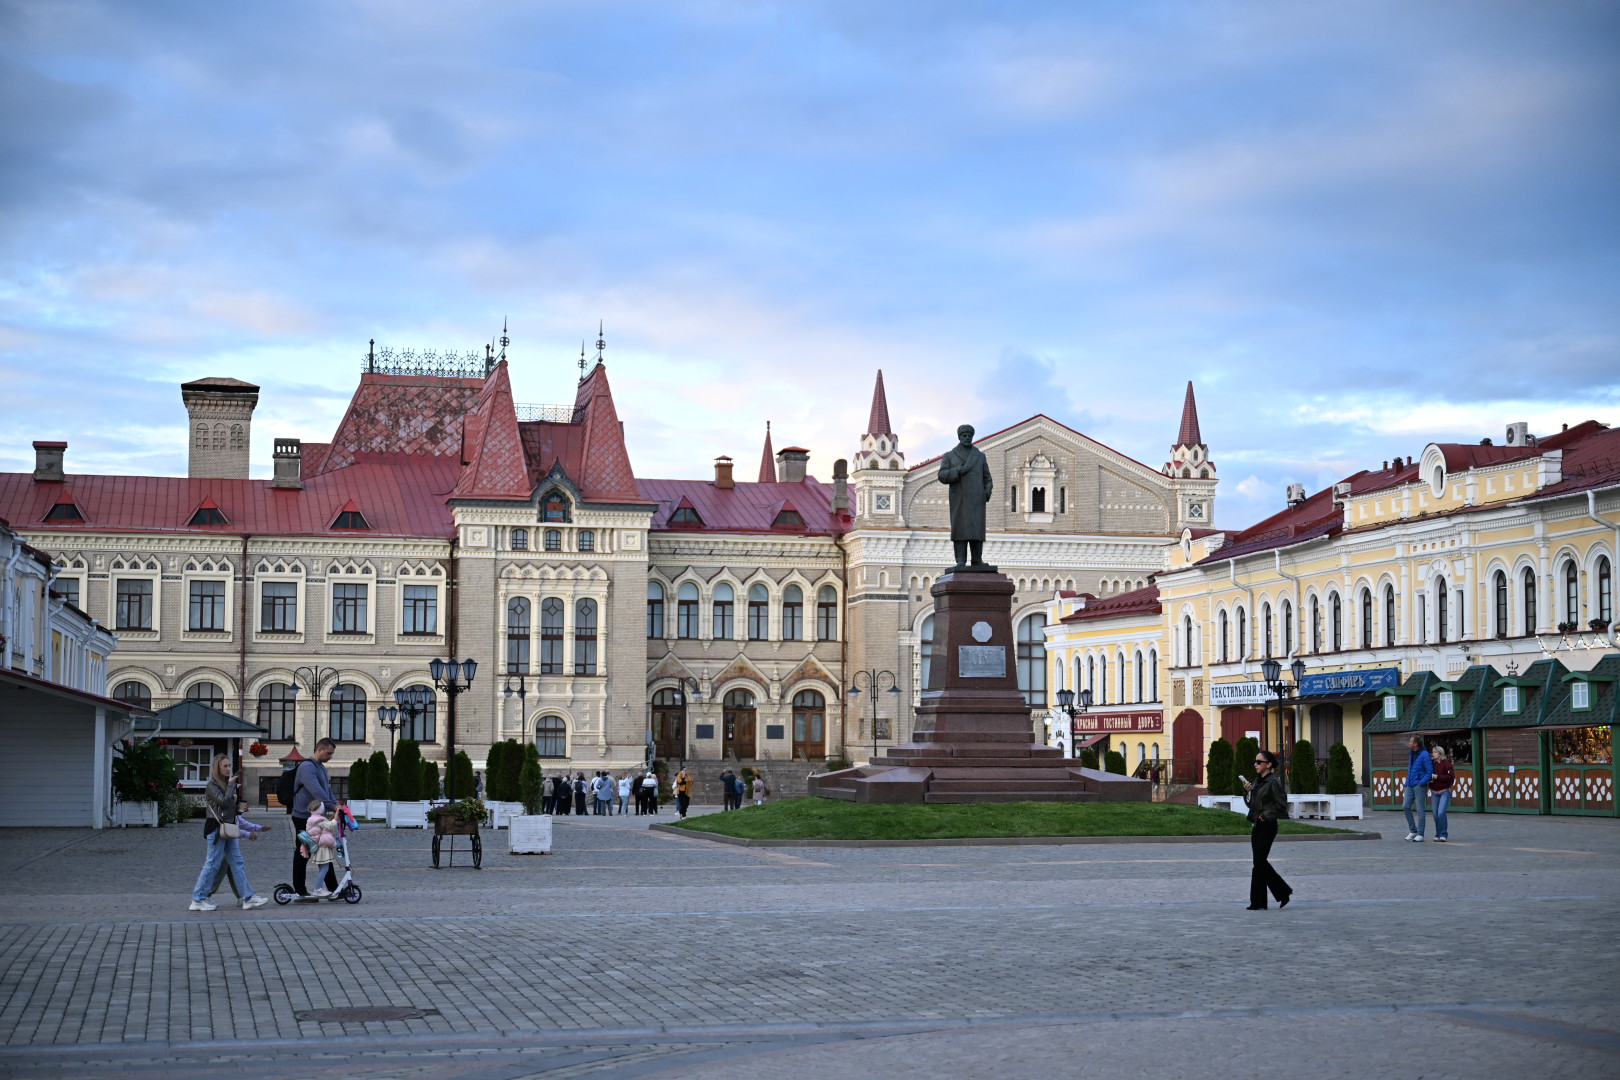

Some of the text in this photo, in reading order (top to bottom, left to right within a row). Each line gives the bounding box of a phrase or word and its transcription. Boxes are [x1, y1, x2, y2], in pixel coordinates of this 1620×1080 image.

[1211, 684, 1257, 698] ТЕКСТИЛЬНЫЙ
[1077, 714, 1154, 730] КРАСНЫЙ ГОСТИННЫЙ ДВОРЪ
